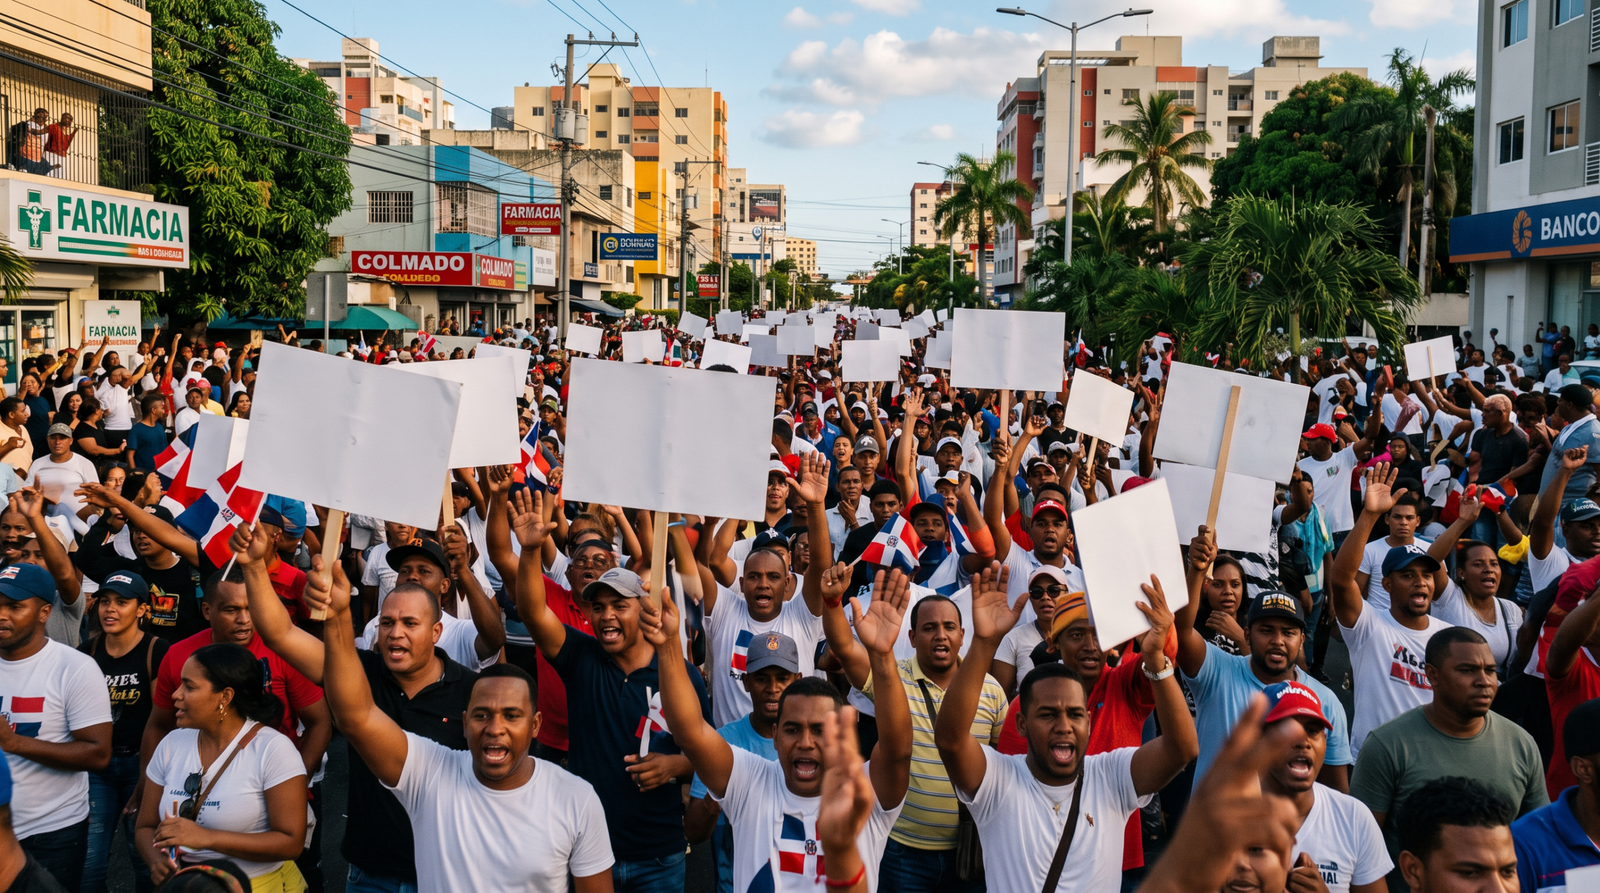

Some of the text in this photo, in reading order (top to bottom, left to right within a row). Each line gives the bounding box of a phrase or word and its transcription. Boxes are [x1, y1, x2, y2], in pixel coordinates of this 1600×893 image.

[57, 195, 184, 243] FARMACIA
[504, 206, 561, 219] FARMACIA
[1541, 211, 1600, 240] BANCO
[357, 254, 465, 272] COLMADO
[481, 258, 513, 277] COLMADO
[89, 326, 137, 337] FARMACIA
